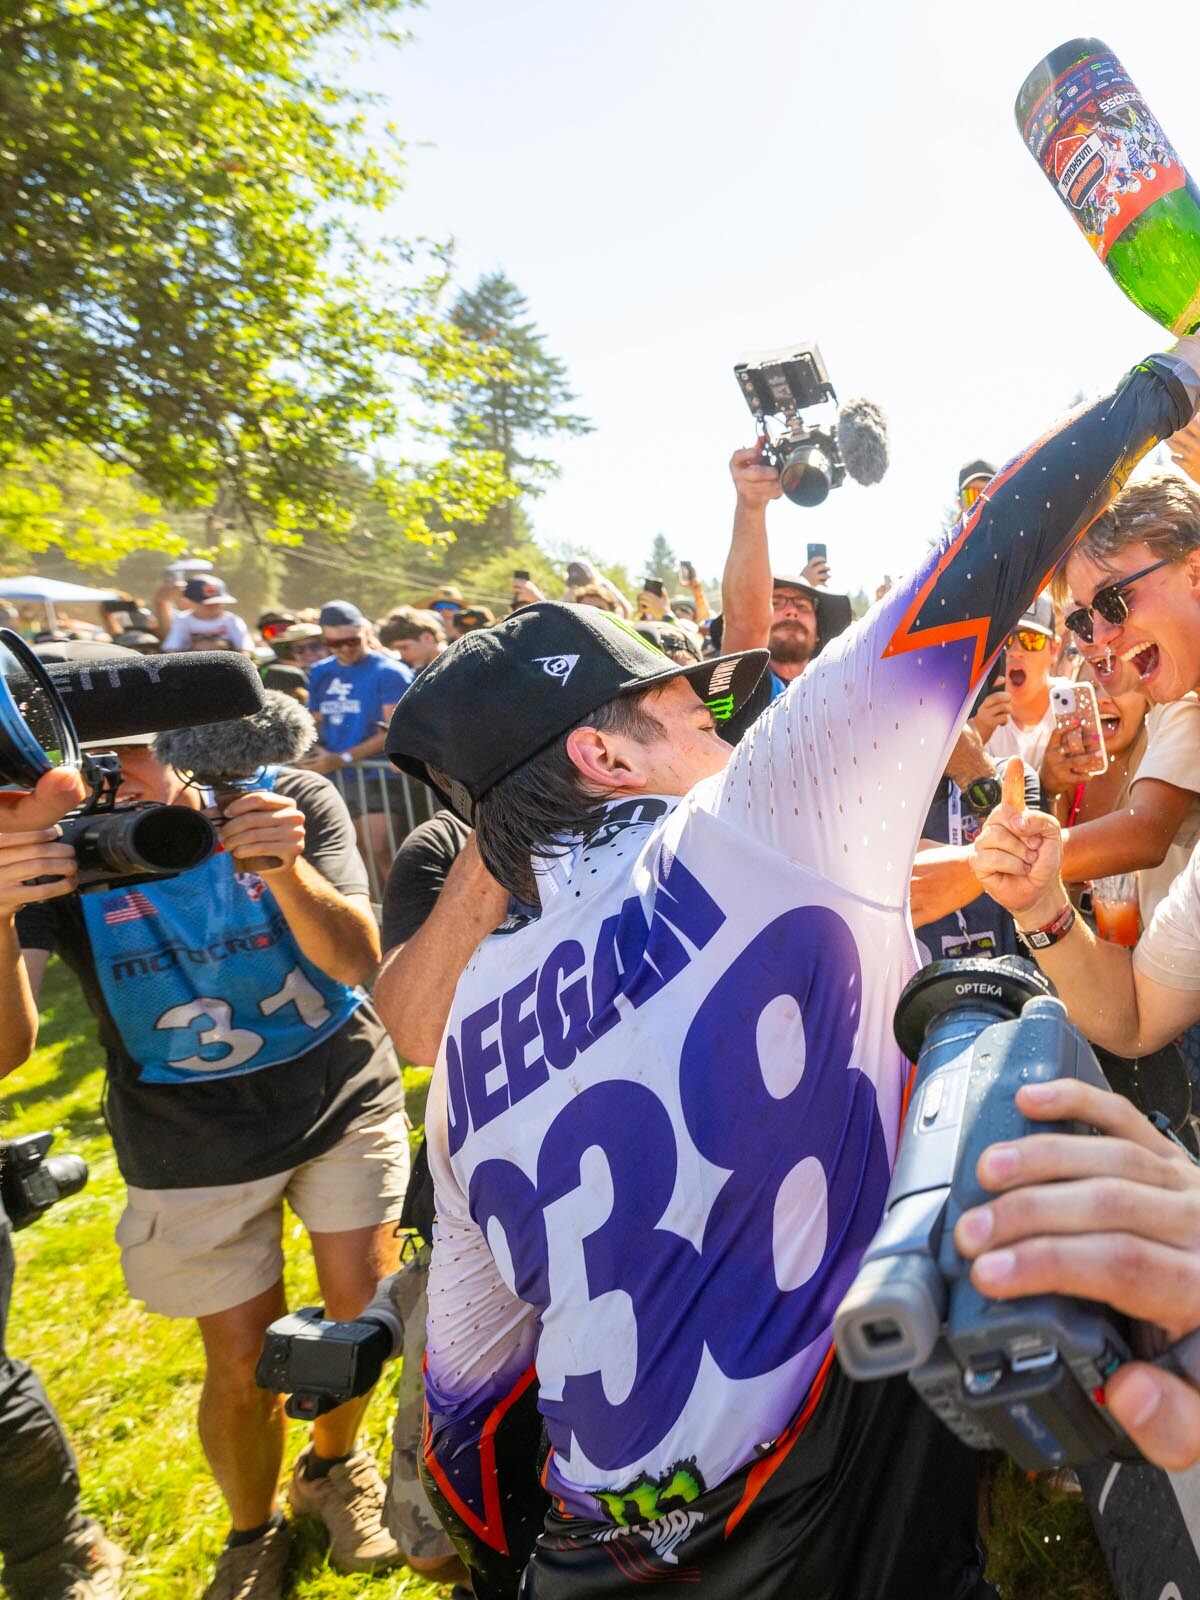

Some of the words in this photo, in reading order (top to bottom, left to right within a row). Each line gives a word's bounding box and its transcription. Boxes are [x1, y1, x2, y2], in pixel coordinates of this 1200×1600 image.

[1061, 143, 1093, 188] WASHOUGAL
[49, 661, 168, 693] EITY
[447, 846, 727, 1158] DEEGAN
[955, 983, 1002, 997] OPTEKA
[155, 962, 333, 1072] 31
